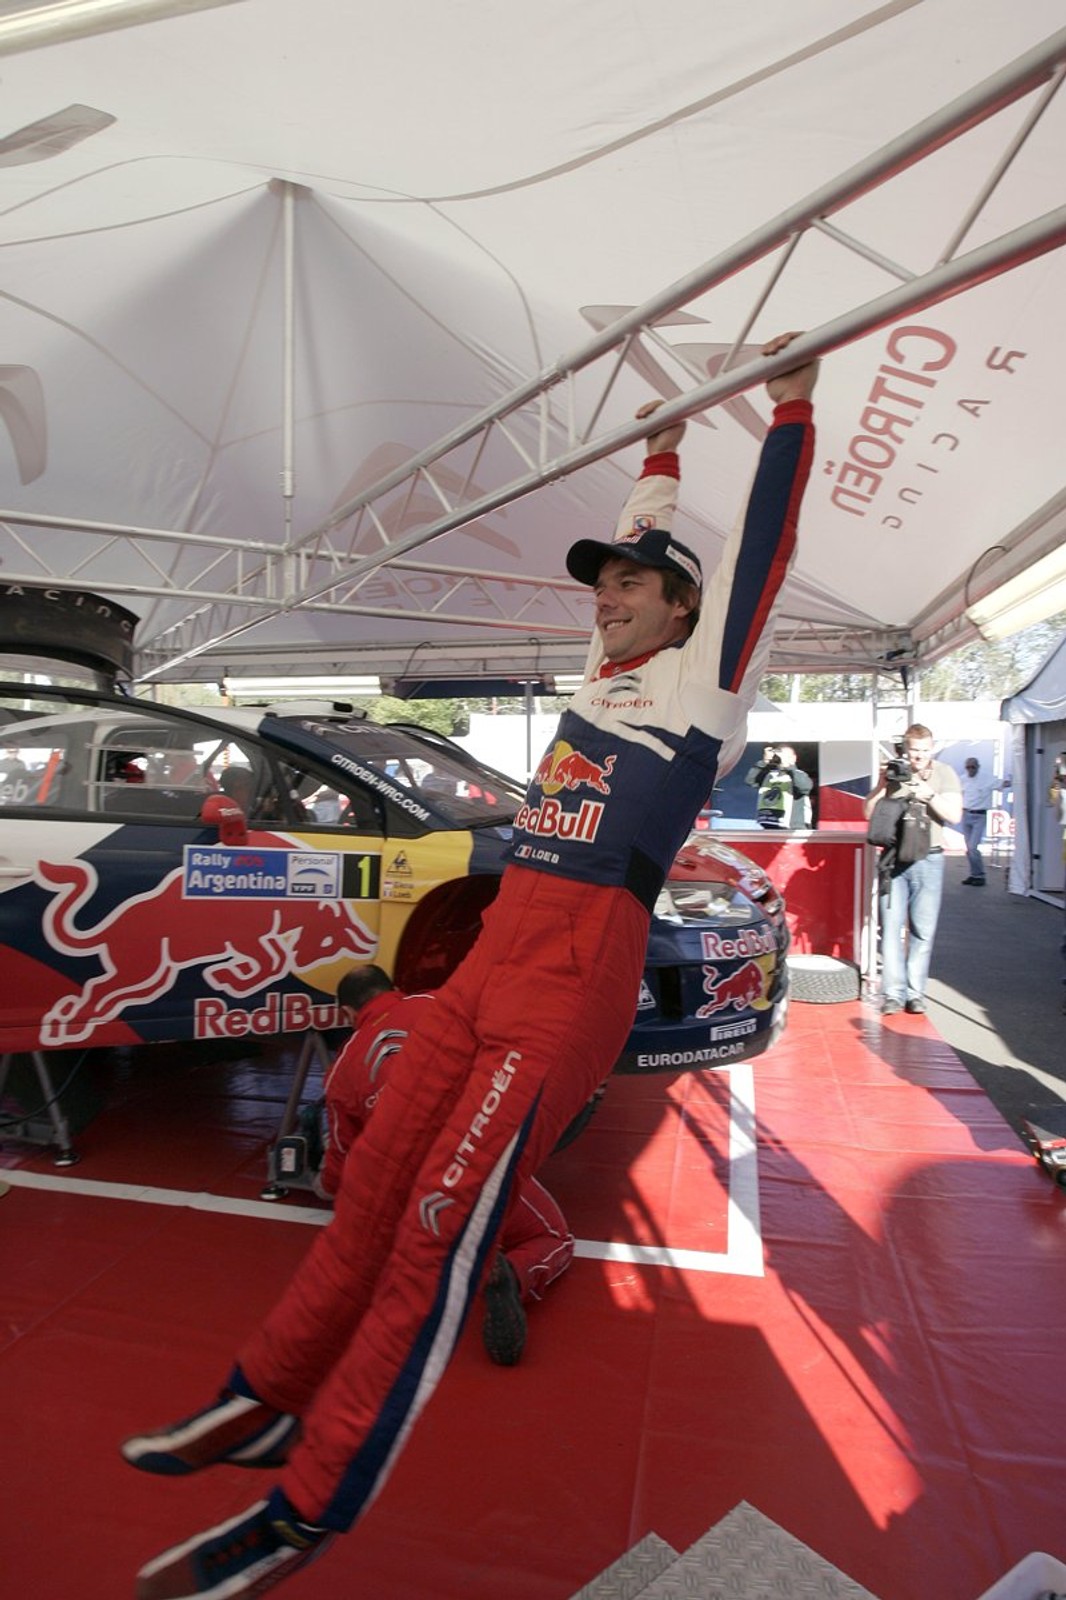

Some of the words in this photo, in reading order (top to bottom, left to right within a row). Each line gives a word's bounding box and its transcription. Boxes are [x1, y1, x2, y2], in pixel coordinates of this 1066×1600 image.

[5, 584, 133, 632] ACING
[0, 779, 28, 802] eb
[535, 798, 605, 844] Bull
[191, 853, 232, 868] Rally
[187, 869, 287, 893] Argentina
[358, 855, 371, 898] 1
[194, 992, 281, 1039] Red
[710, 1018, 757, 1042] PIRELLI
[637, 1042, 745, 1068] EURODATACAR
